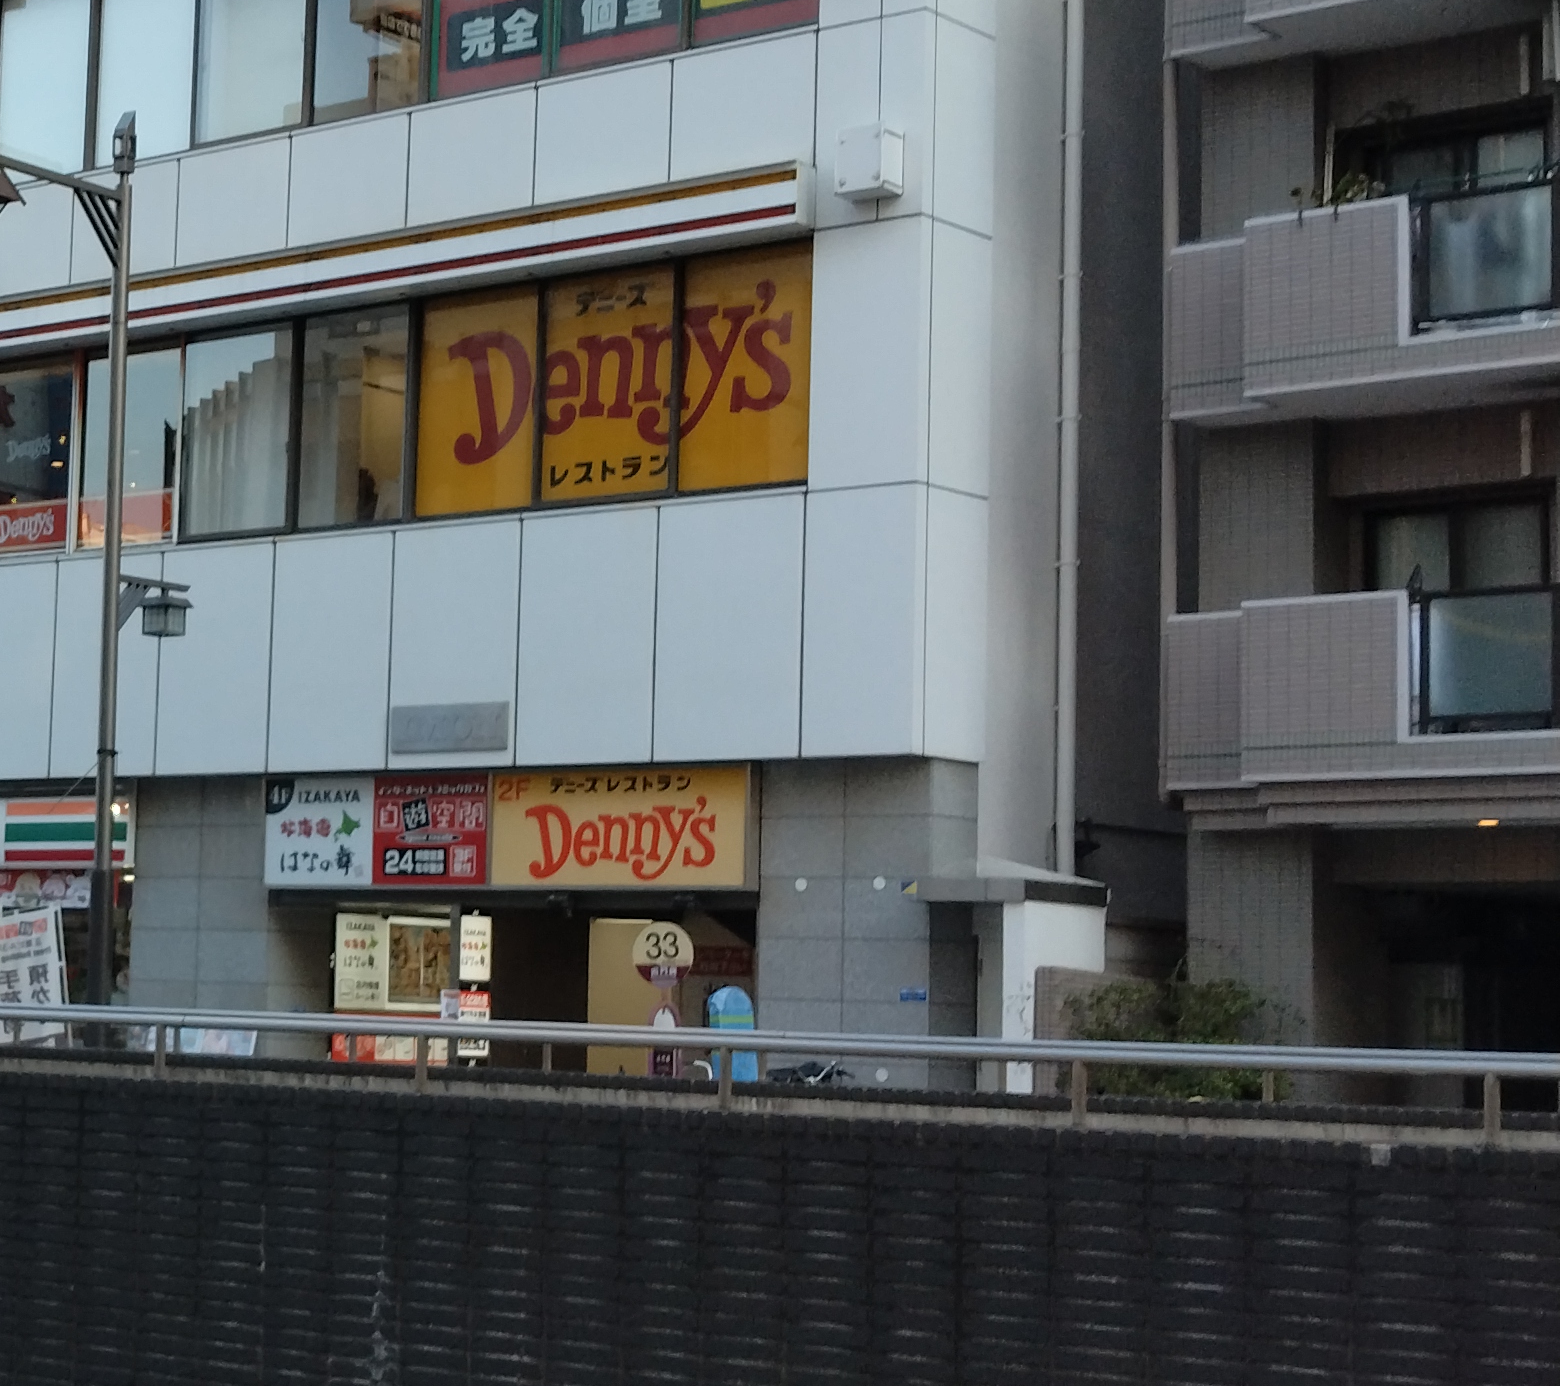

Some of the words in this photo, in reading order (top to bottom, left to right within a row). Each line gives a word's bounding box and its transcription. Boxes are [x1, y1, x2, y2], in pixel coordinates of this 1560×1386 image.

[460, 7, 539, 63] 完全
[448, 280, 792, 466] Denny's
[549, 454, 669, 489] レストラン
[298, 789, 361, 804] IZAKAYA
[497, 777, 530, 801] 2F
[525, 795, 716, 881] Denny's
[385, 849, 414, 874] 24
[645, 931, 679, 960] 33
